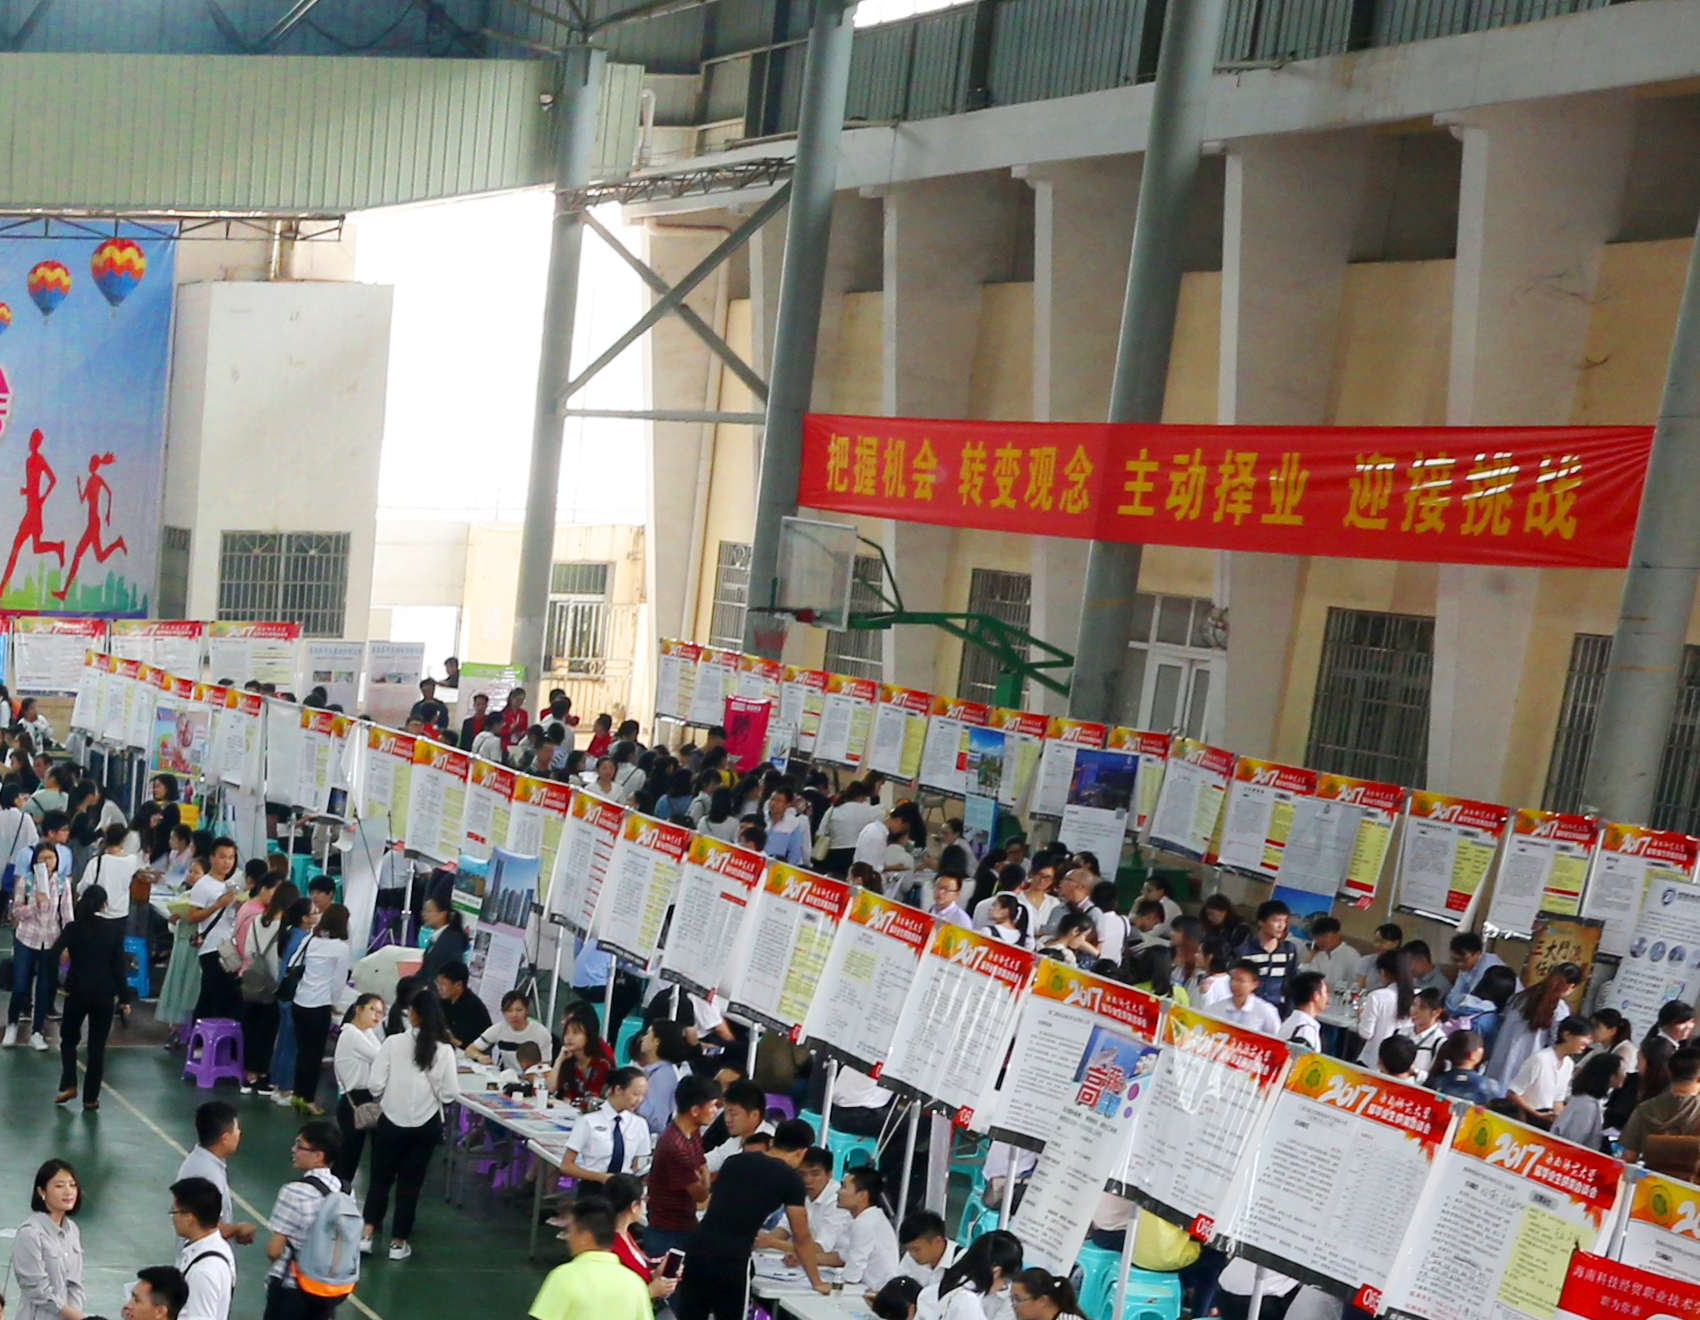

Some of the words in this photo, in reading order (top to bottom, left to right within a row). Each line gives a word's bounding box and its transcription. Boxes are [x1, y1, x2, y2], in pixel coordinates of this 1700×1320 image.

[826, 433, 938, 501] 把握机会
[958, 443, 1092, 515] 转变观念
[1118, 448, 1308, 528] 主动择业
[1342, 450, 1584, 540] 迎接挑战
[1063, 979, 1104, 1012] 2017
[1317, 1073, 1378, 1118] 2017
[1484, 1133, 1546, 1178] 2017
